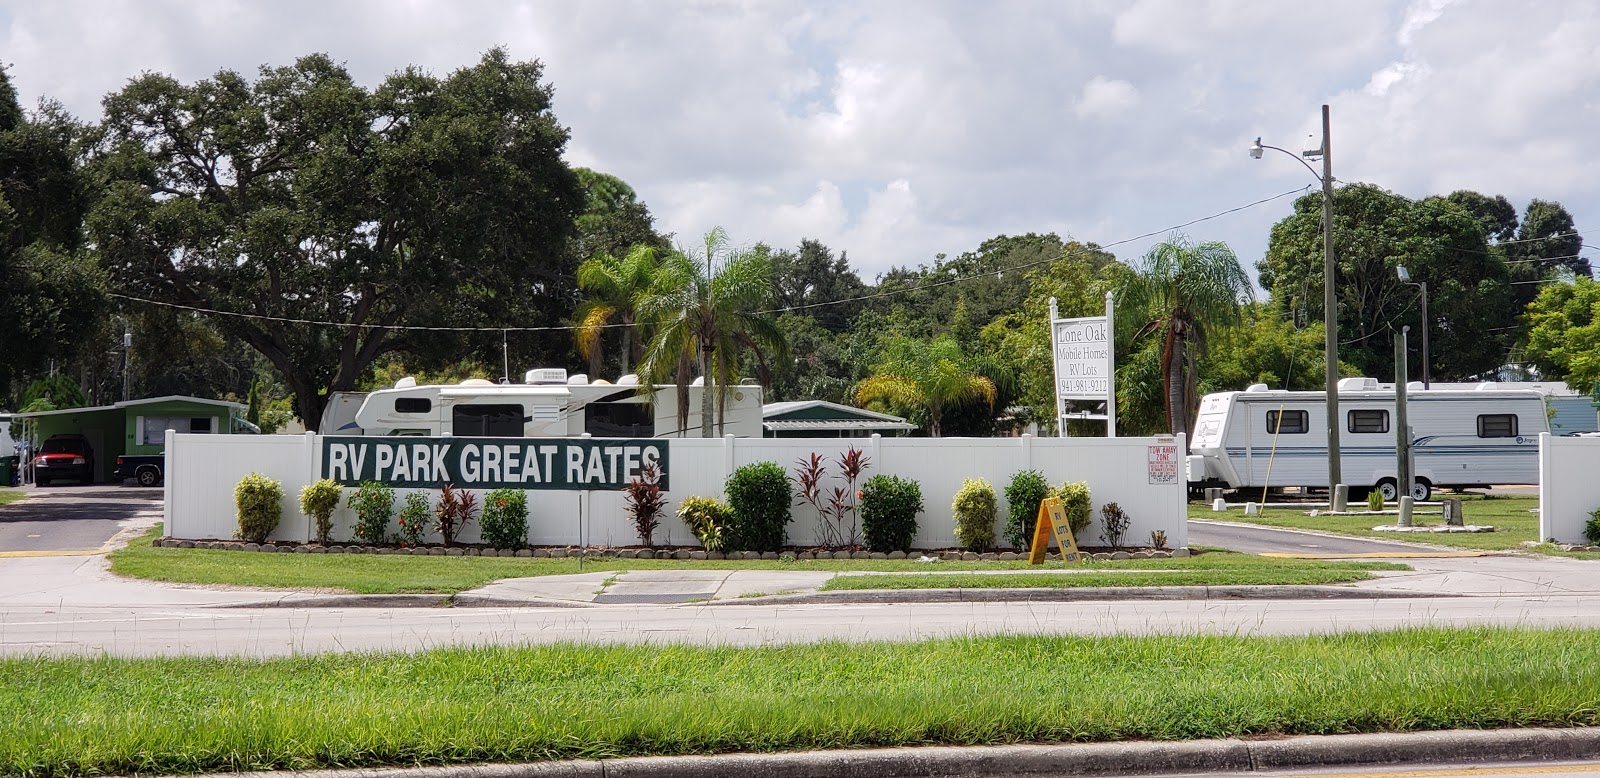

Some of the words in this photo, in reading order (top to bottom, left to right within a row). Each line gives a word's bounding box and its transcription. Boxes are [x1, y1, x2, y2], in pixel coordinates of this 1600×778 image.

[1059, 327, 1082, 343] Lone
[1085, 324, 1107, 341] Oak
[1059, 347, 1082, 360] Mobile
[1083, 346, 1108, 359] Homes
[1070, 363, 1080, 376] RV
[1082, 363, 1097, 376] Lots
[1061, 379, 1107, 392] 941-981-9212
[328, 444, 367, 481] RV
[375, 444, 451, 482] PARK
[460, 445, 557, 483] GREAT
[566, 445, 661, 485] RATES
[1056, 525, 1069, 535] LOTS
[1061, 539, 1072, 549] FOR
